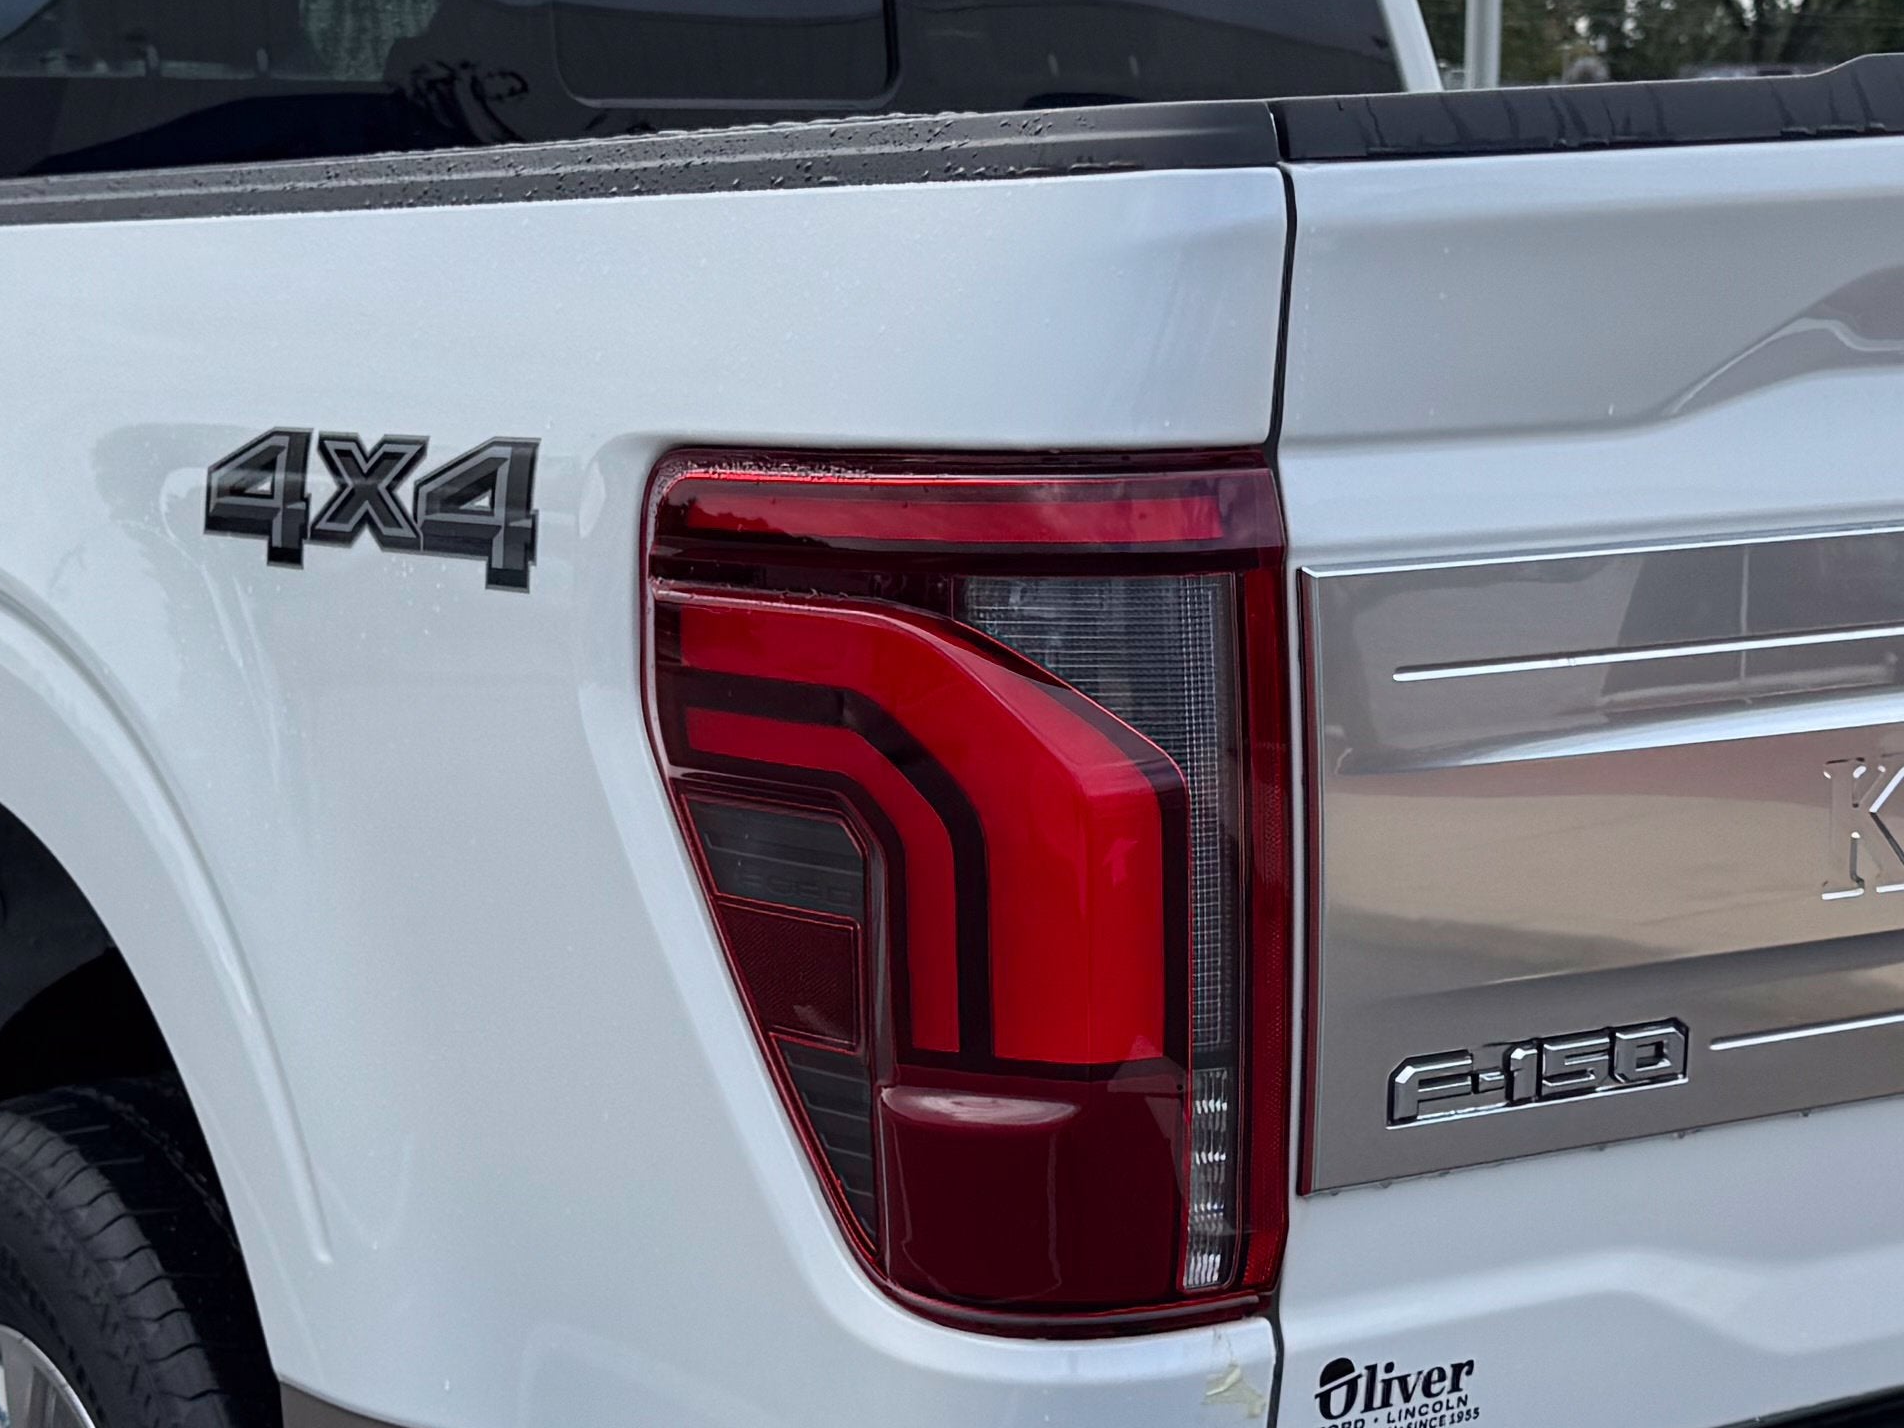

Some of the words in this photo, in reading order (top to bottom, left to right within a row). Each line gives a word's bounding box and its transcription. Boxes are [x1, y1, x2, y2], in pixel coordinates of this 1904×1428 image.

[203, 426, 542, 594] 4X4
[1386, 1017, 1689, 1129] F-150
[1314, 1357, 1475, 1420] Oliver
[1386, 1394, 1469, 1424] LINCOLN
[1449, 1406, 1480, 1424] 1955
